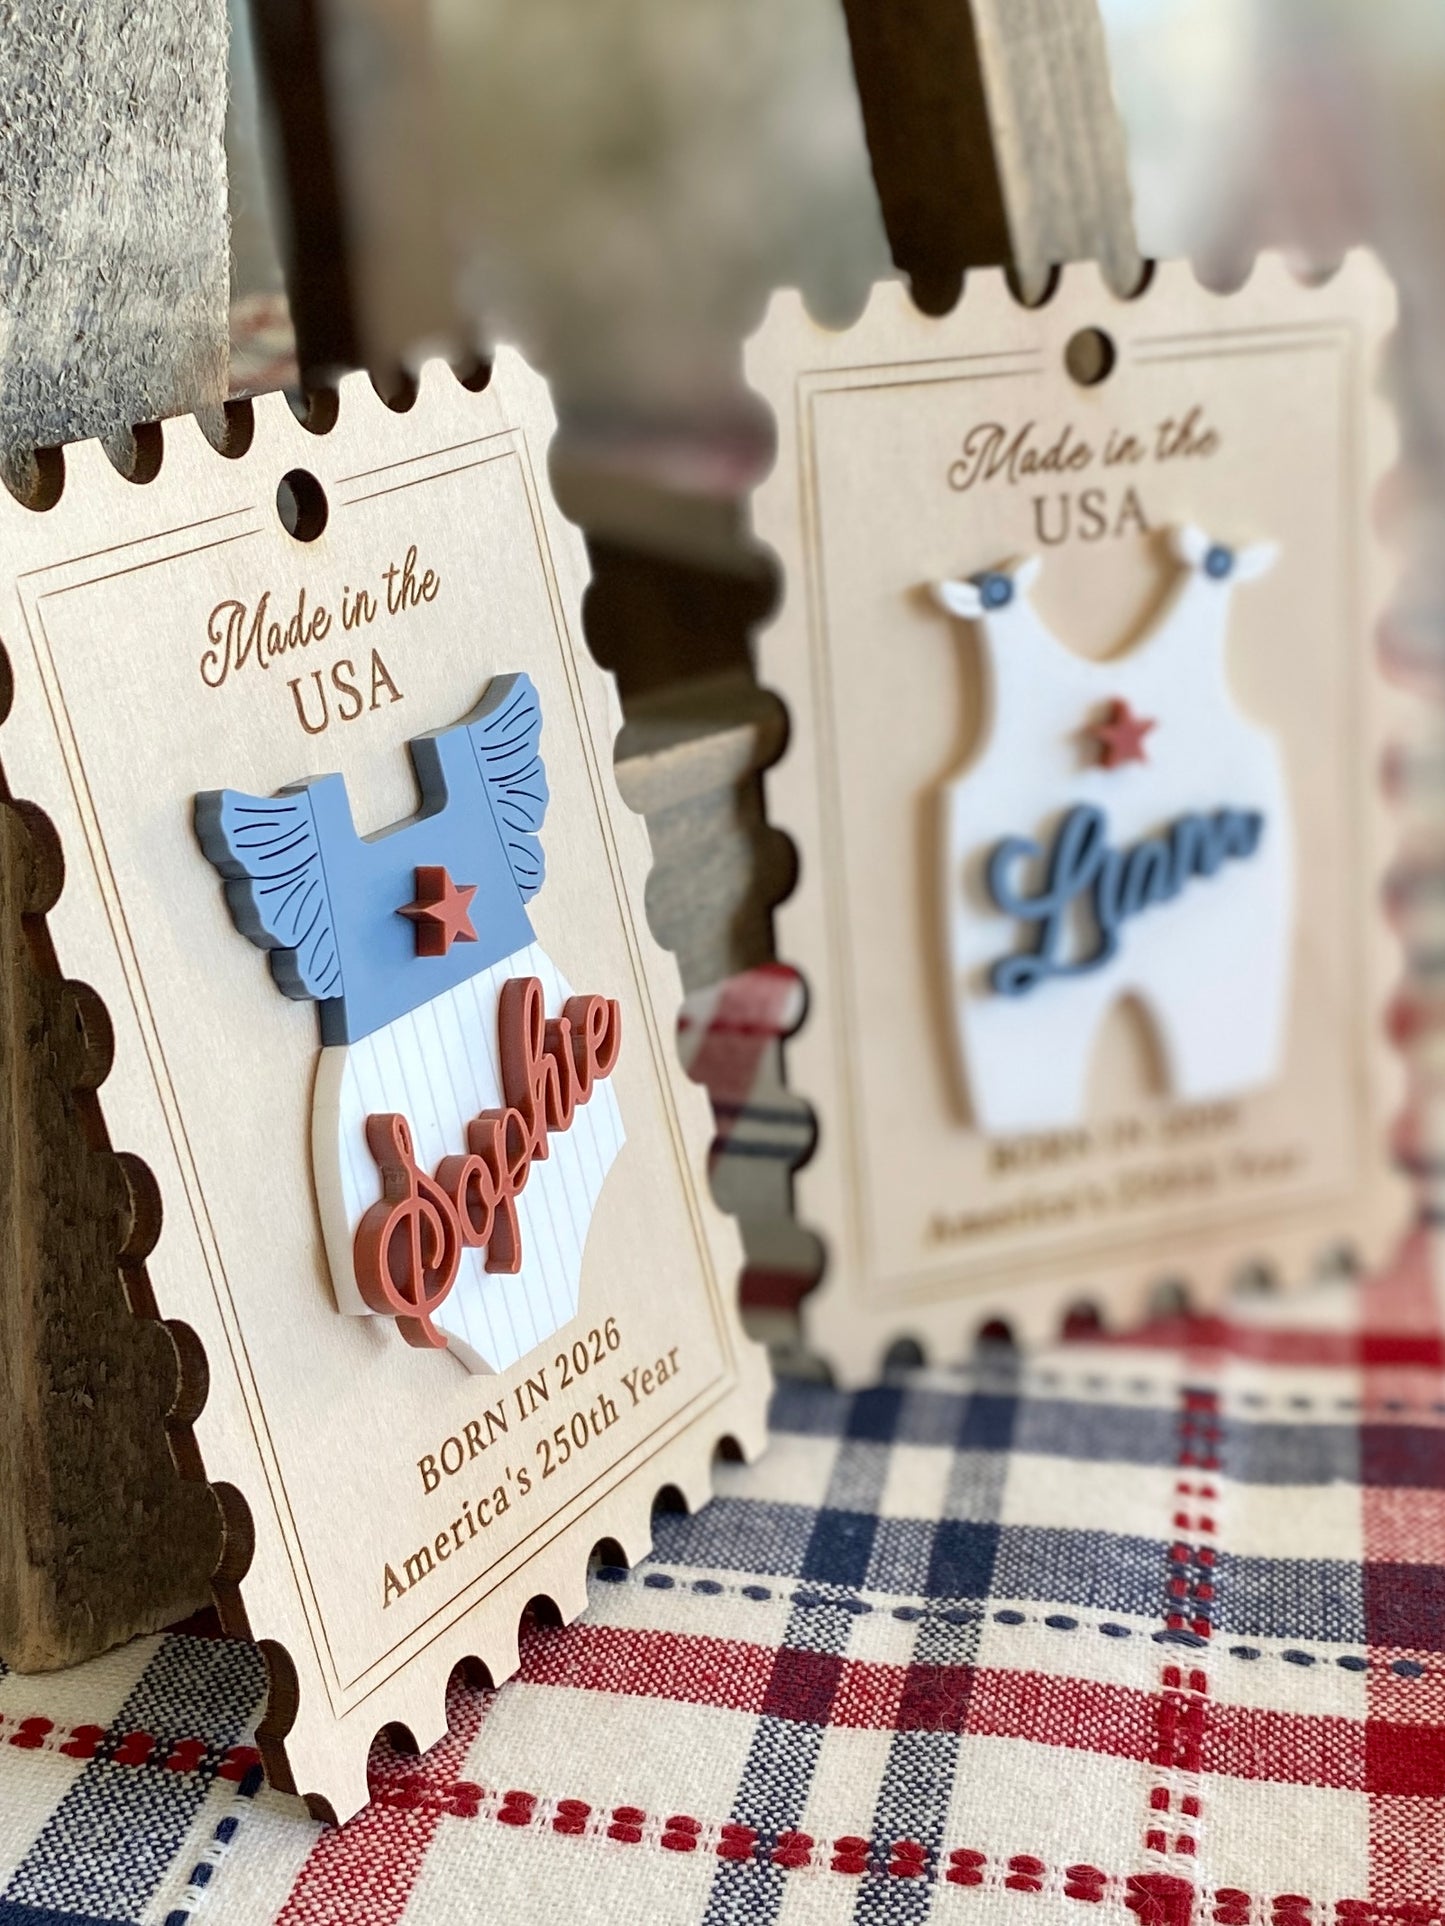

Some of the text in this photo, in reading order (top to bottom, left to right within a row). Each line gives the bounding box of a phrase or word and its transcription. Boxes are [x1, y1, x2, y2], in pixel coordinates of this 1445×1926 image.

[947, 405, 1221, 493] Made in the
[1033, 485, 1150, 546] USA
[200, 545, 441, 688] Made in the
[286, 648, 404, 735] USA
[354, 976, 622, 1349] Sophie
[417, 1316, 622, 1496] BORN IN 2026
[382, 1346, 681, 1610] America's 250th Year
